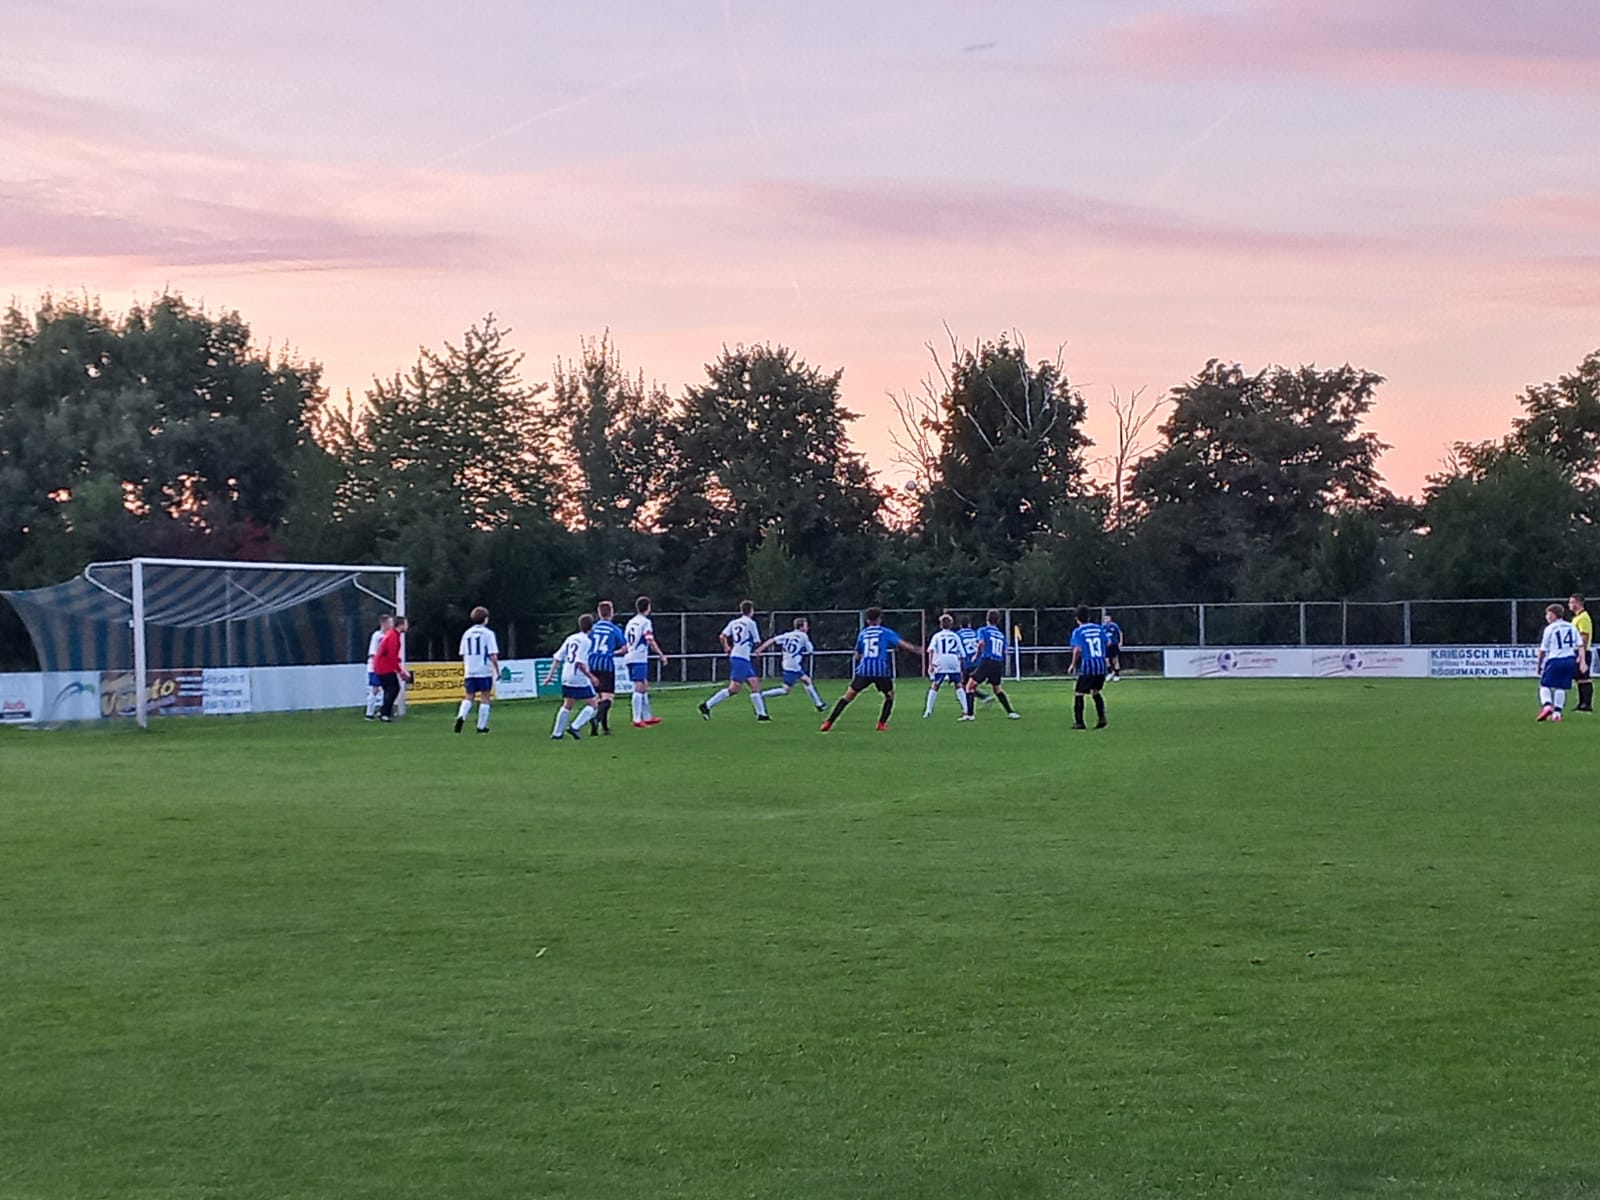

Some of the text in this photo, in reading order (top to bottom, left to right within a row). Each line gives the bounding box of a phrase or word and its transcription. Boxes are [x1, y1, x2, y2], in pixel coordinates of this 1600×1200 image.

[593, 633, 609, 654] 14
[628, 626, 636, 646] 6
[733, 625, 743, 644] 3
[1555, 628, 1574, 649] 14
[467, 635, 481, 656] 11
[566, 642, 579, 664] 13
[863, 637, 880, 658] 15
[941, 638, 959, 655] 12
[1085, 636, 1102, 658] 13
[1431, 649, 1538, 659] KRIEGSCH METALL
